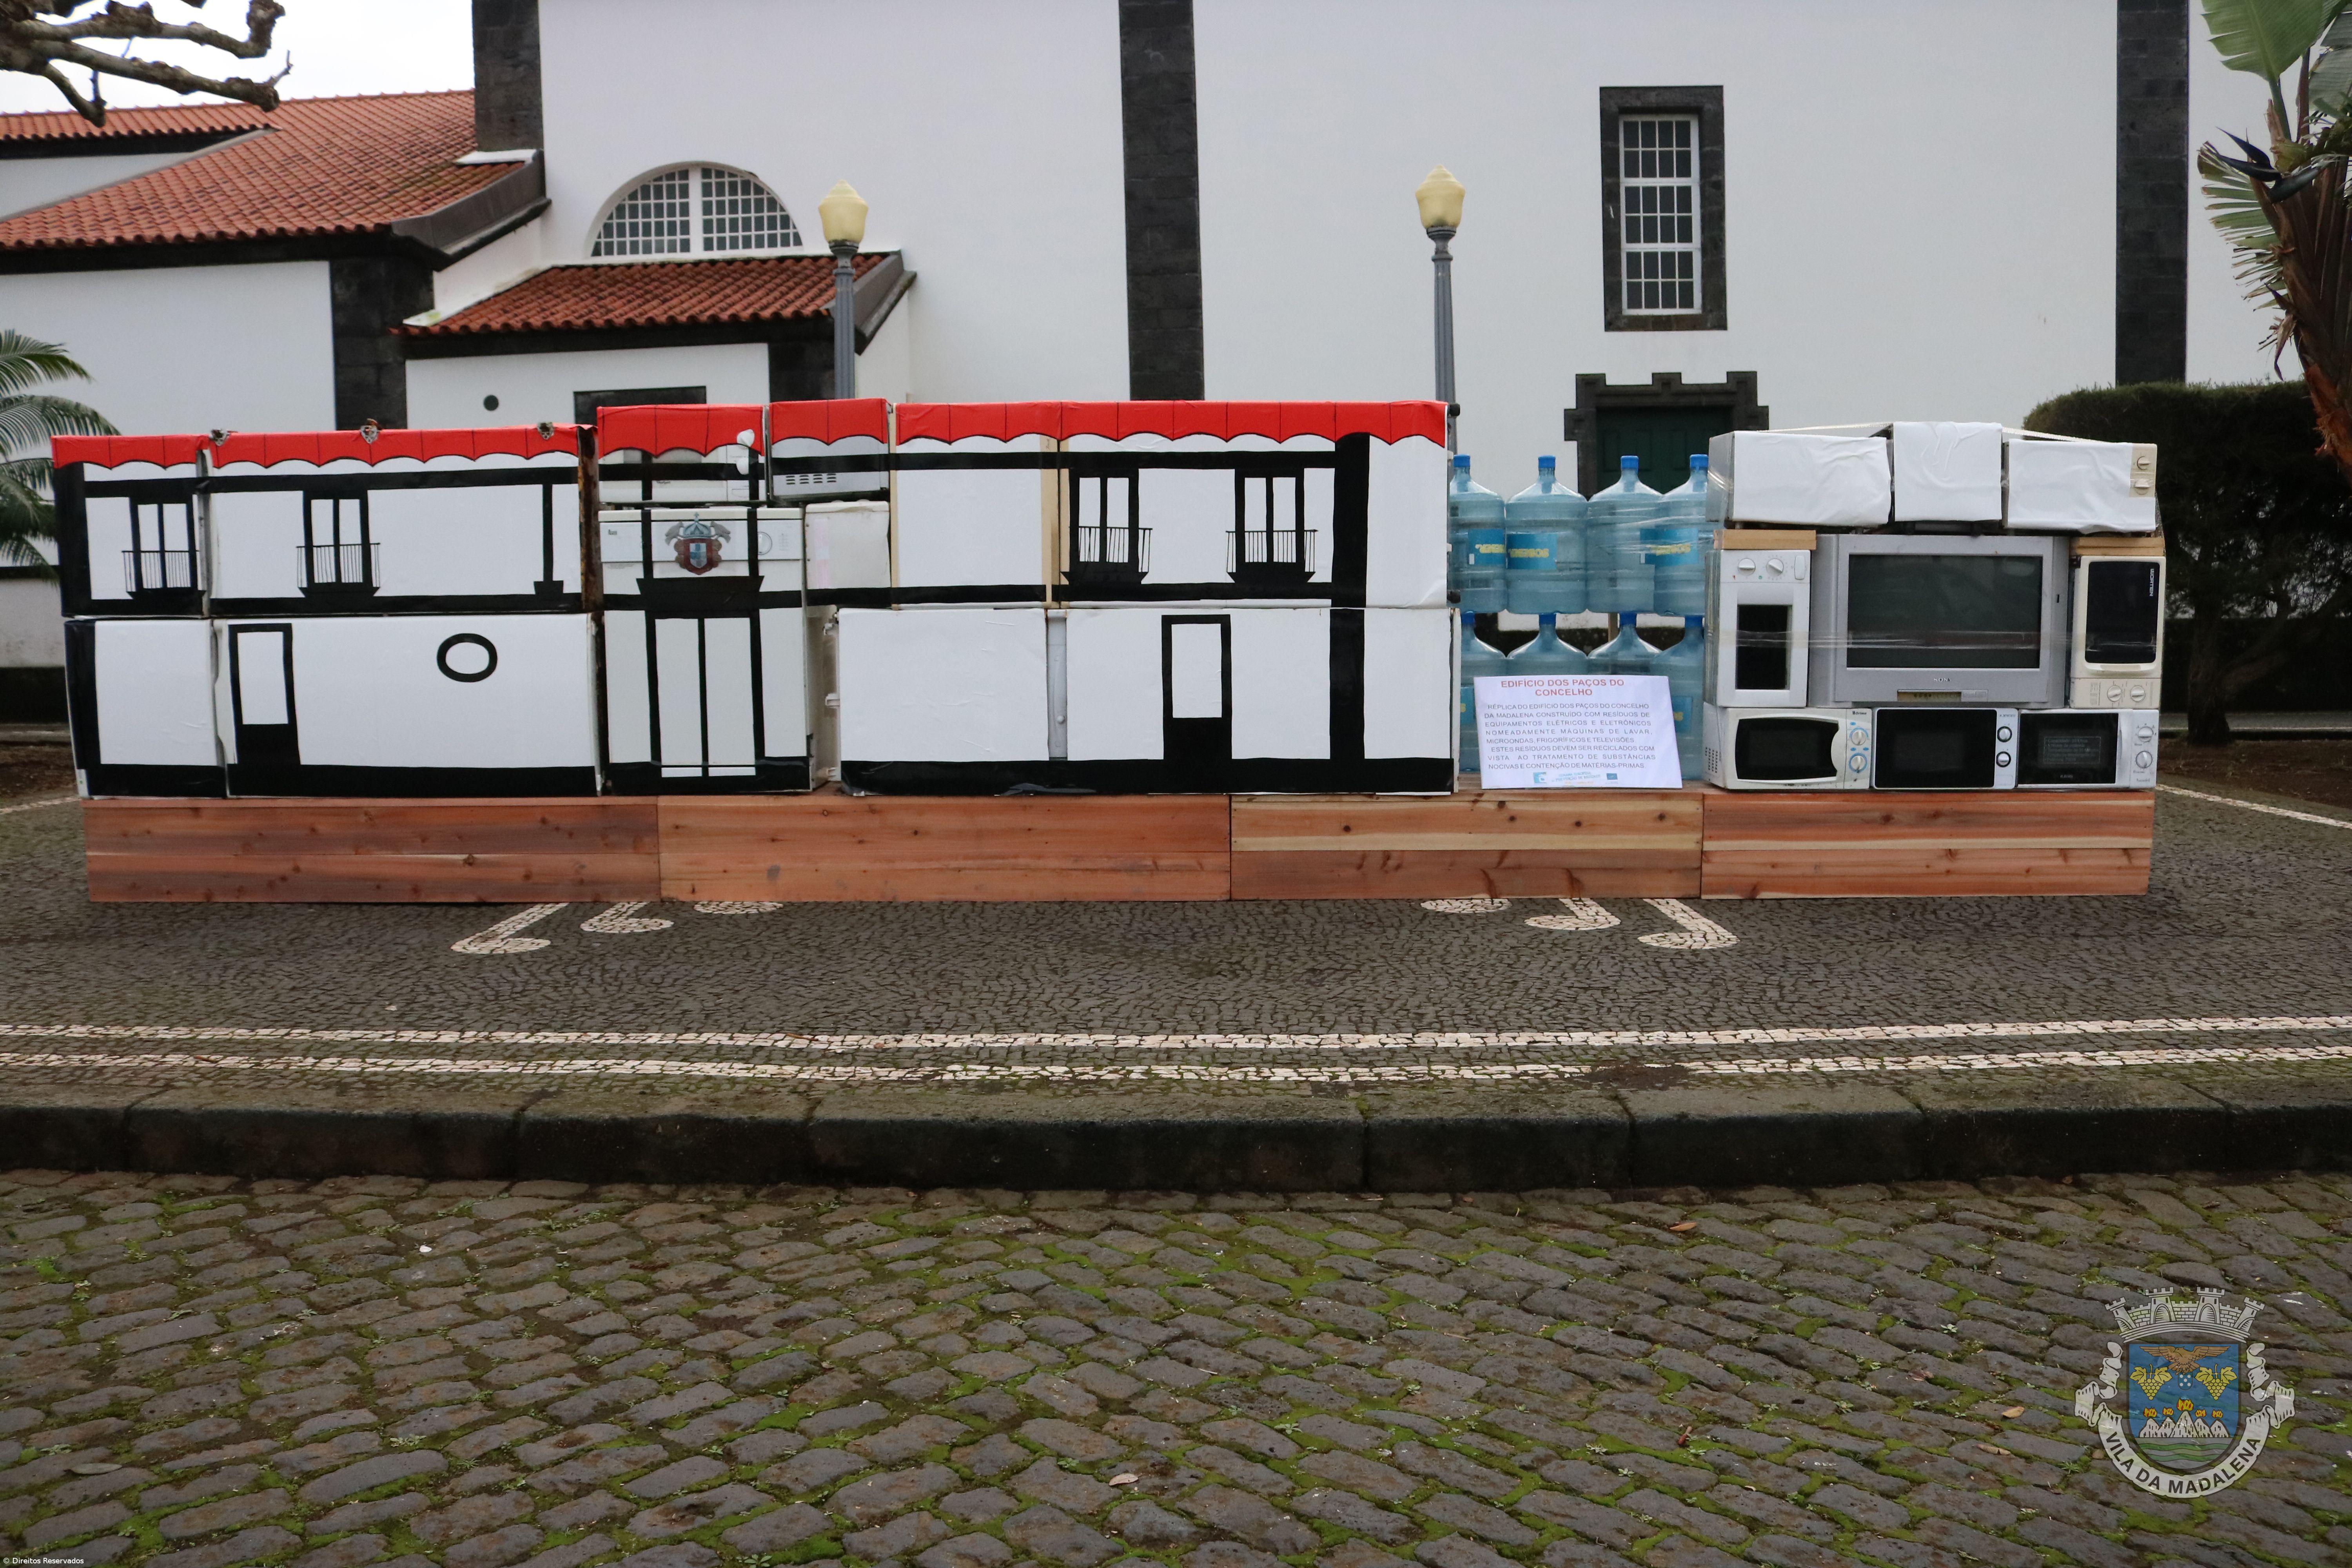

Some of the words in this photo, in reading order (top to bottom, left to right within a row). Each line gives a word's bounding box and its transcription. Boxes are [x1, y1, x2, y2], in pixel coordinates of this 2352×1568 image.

[1501, 678, 1544, 688] EDIFÍCIO
[1548, 679, 1568, 687] DOS
[1572, 679, 1606, 688] PAÇOS
